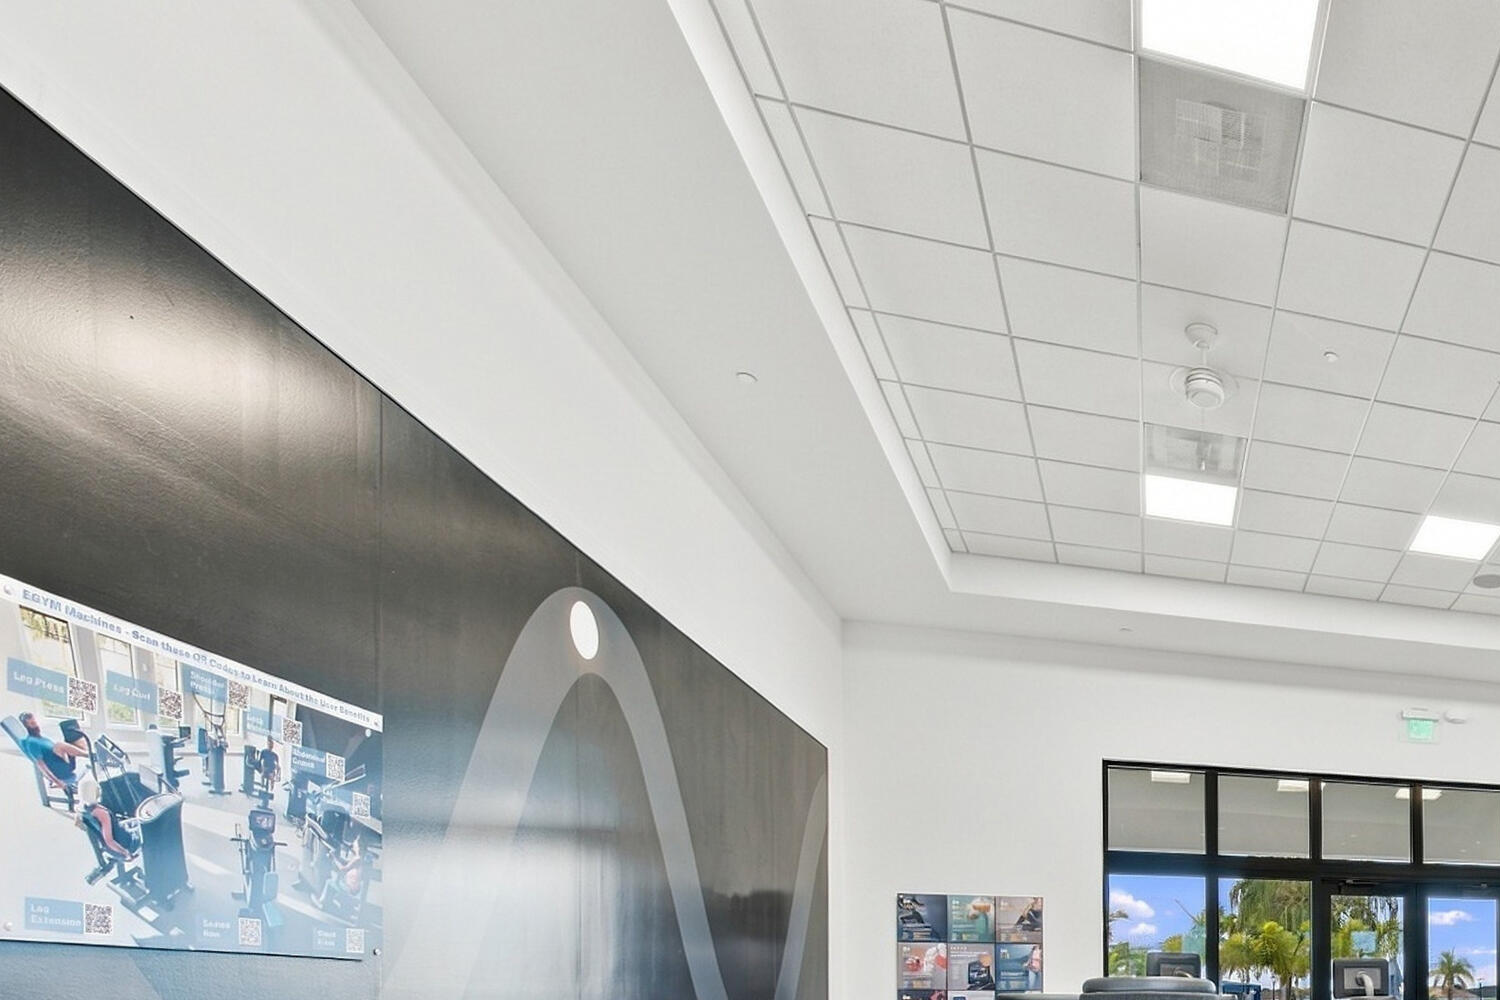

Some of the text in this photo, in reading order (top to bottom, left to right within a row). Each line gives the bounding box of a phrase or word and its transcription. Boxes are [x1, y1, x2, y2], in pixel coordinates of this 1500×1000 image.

[22, 588, 61, 612] EGYM
[65, 604, 122, 634] Machines
[132, 630, 159, 646] Scan
[161, 641, 191, 659] these
[193, 652, 208, 666] QR
[209, 658, 239, 677] Codes
[241, 669, 251, 681] to
[253, 673, 278, 690] Learn
[279, 683, 305, 700] About
[305, 692, 321, 705] the
[13, 671, 65, 694] Leg Press
[31, 914, 82, 927] Extension
